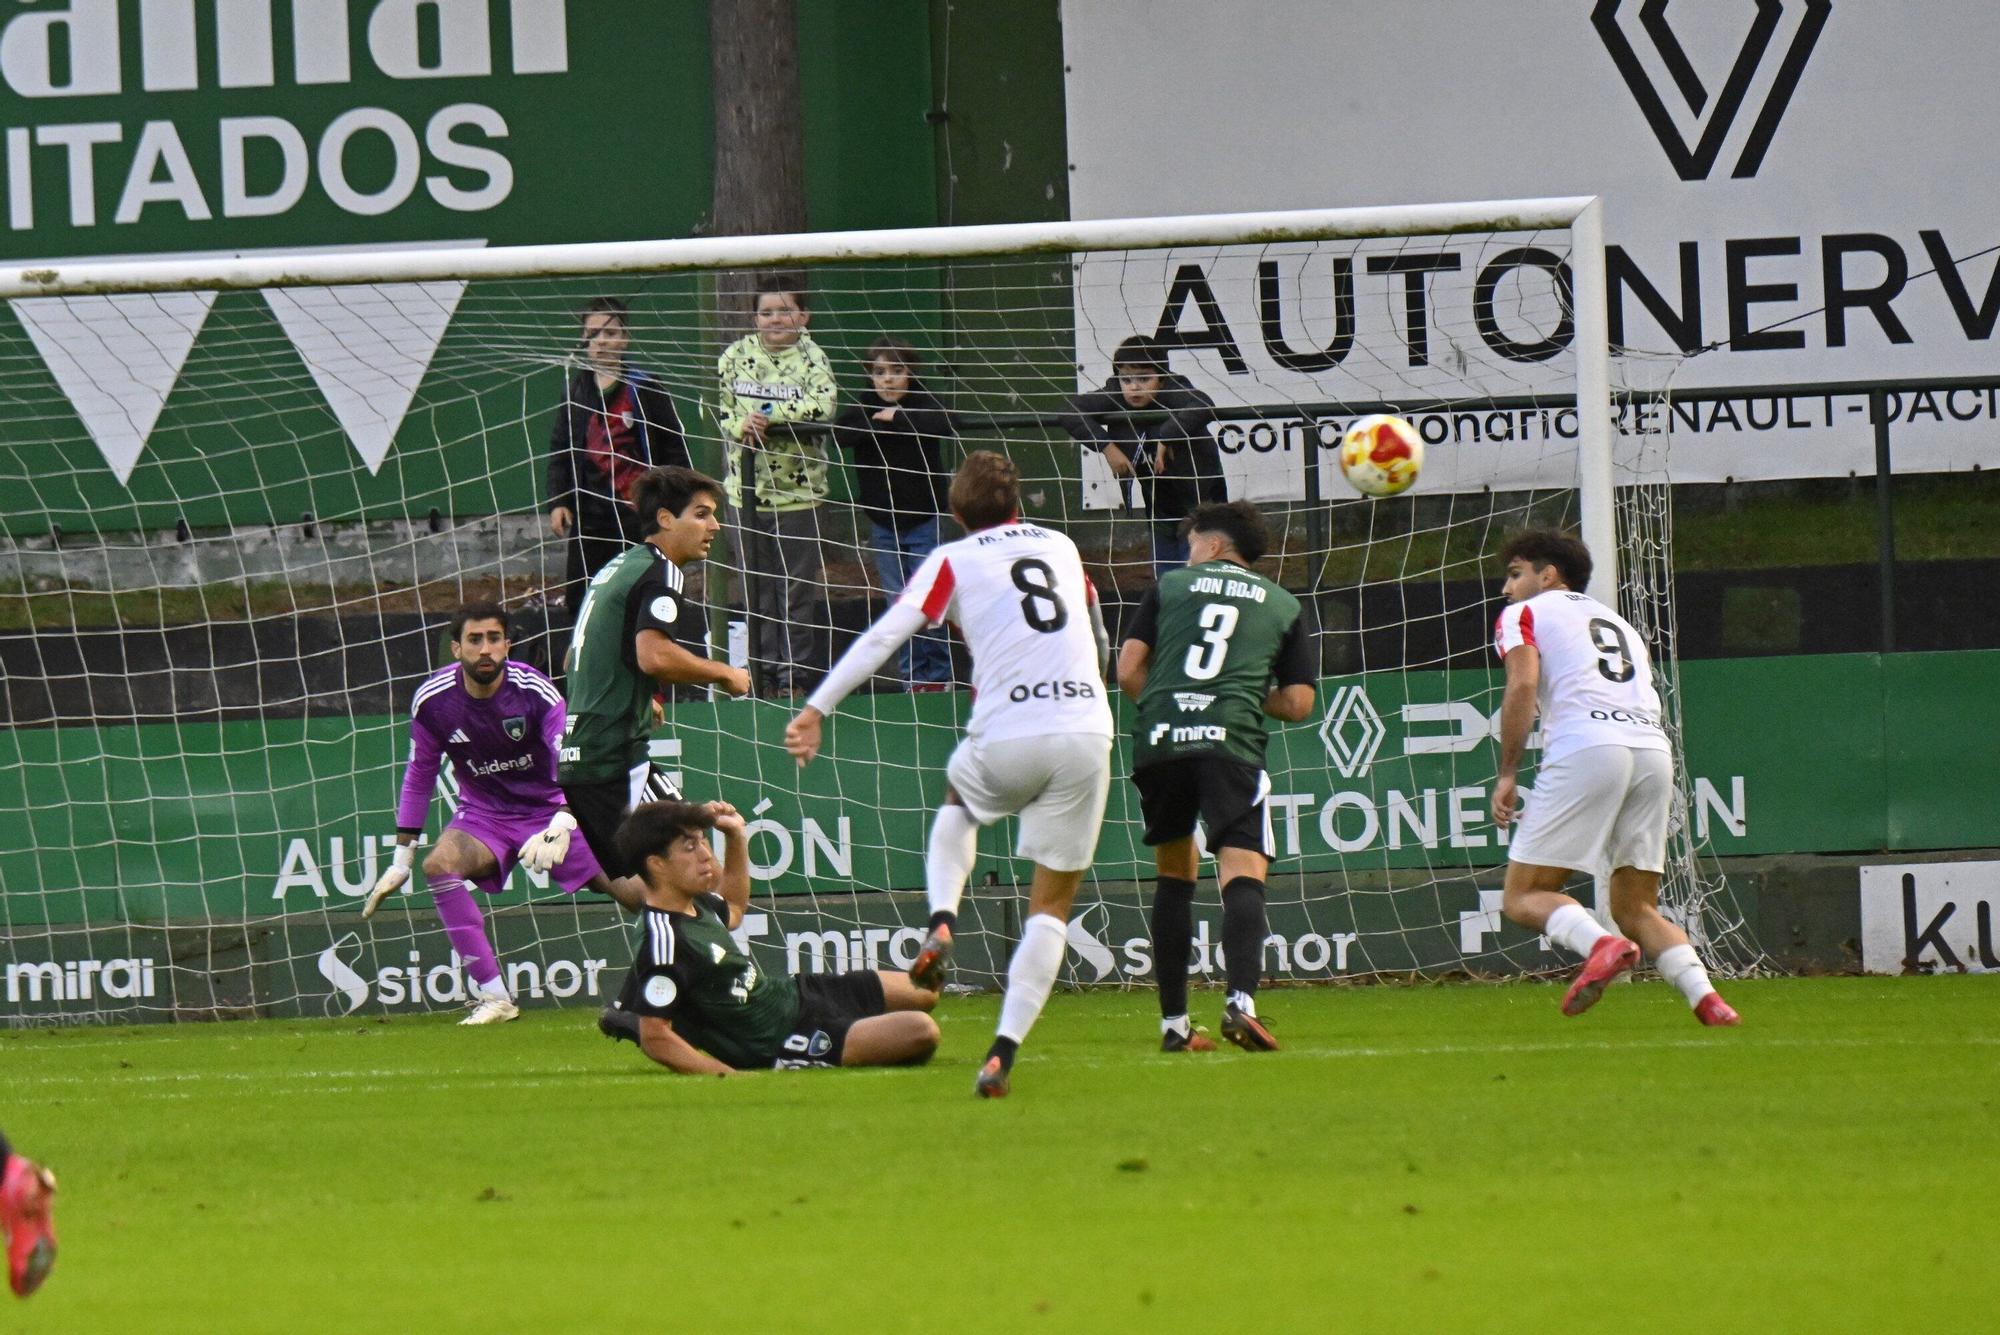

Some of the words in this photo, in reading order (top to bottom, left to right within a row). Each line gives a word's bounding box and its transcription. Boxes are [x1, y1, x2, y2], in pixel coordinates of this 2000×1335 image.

[7, 103, 514, 230] ITADOS
[1217, 408, 1579, 455] conconario
[1011, 558, 1069, 634] 8
[1189, 577, 1223, 594] JON
[1225, 579, 1267, 603] ROJO
[1184, 602, 1239, 680] 3
[1589, 617, 1636, 684] 9
[1010, 680, 1096, 702] ocisa
[1173, 725, 1227, 742] mirai
[786, 926, 931, 976] mira
[1123, 920, 1357, 976] sdnor
[6, 958, 156, 1002] mirai
